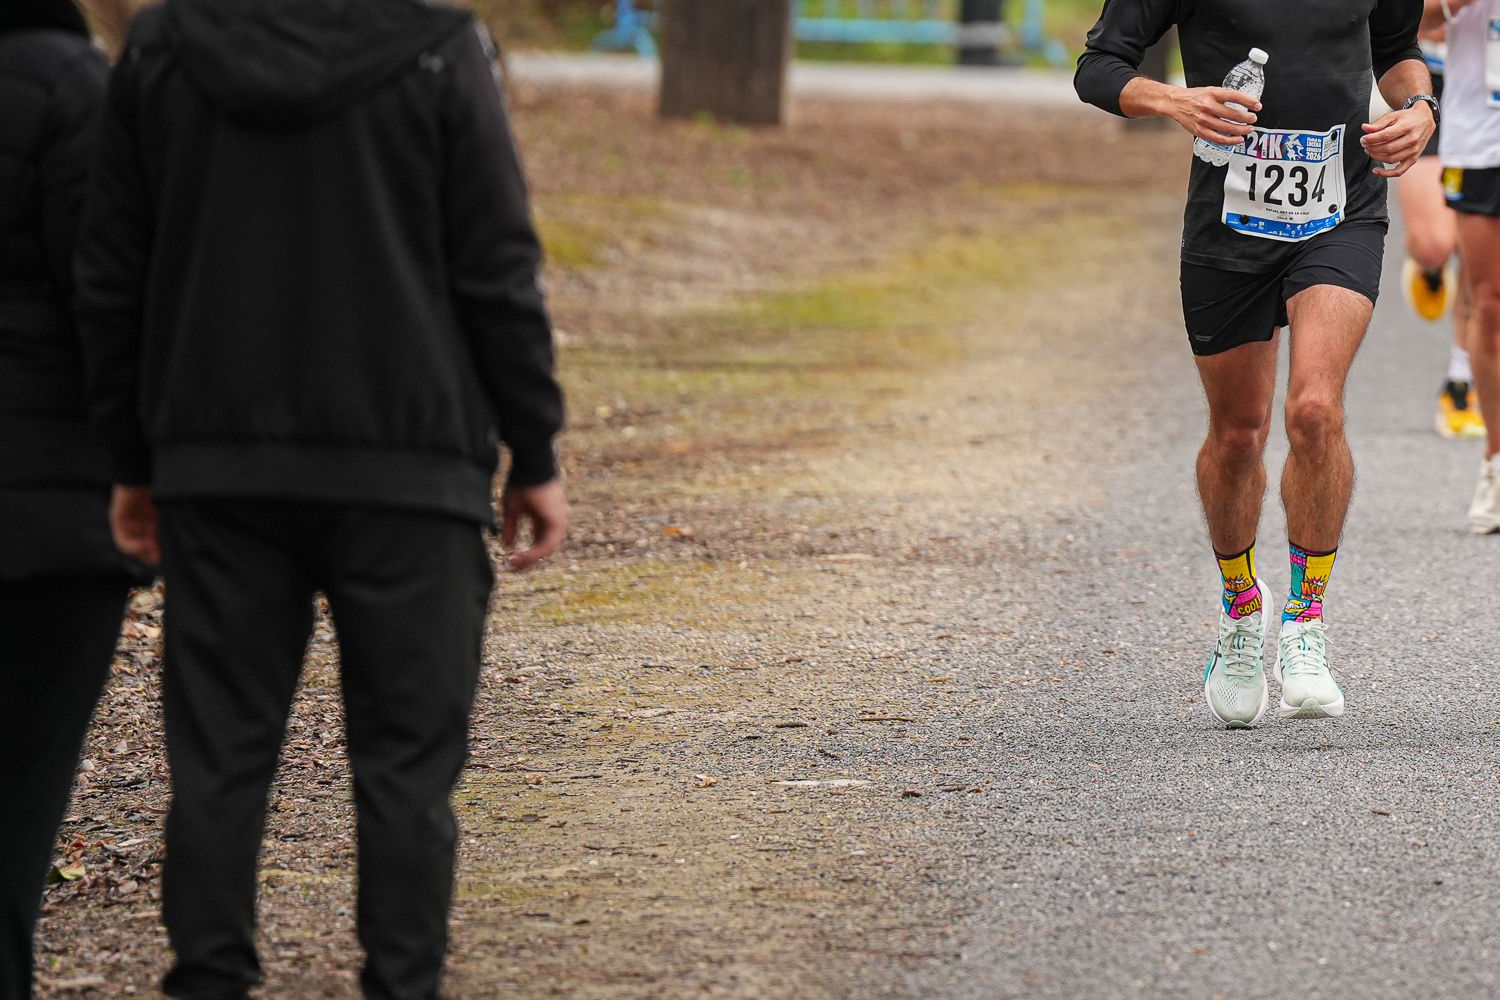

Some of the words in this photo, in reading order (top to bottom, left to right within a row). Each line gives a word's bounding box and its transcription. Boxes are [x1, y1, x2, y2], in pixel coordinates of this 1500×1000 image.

[1246, 131, 1282, 159] 21K
[1306, 152, 1322, 160] 2026
[1245, 163, 1327, 207] 1234
